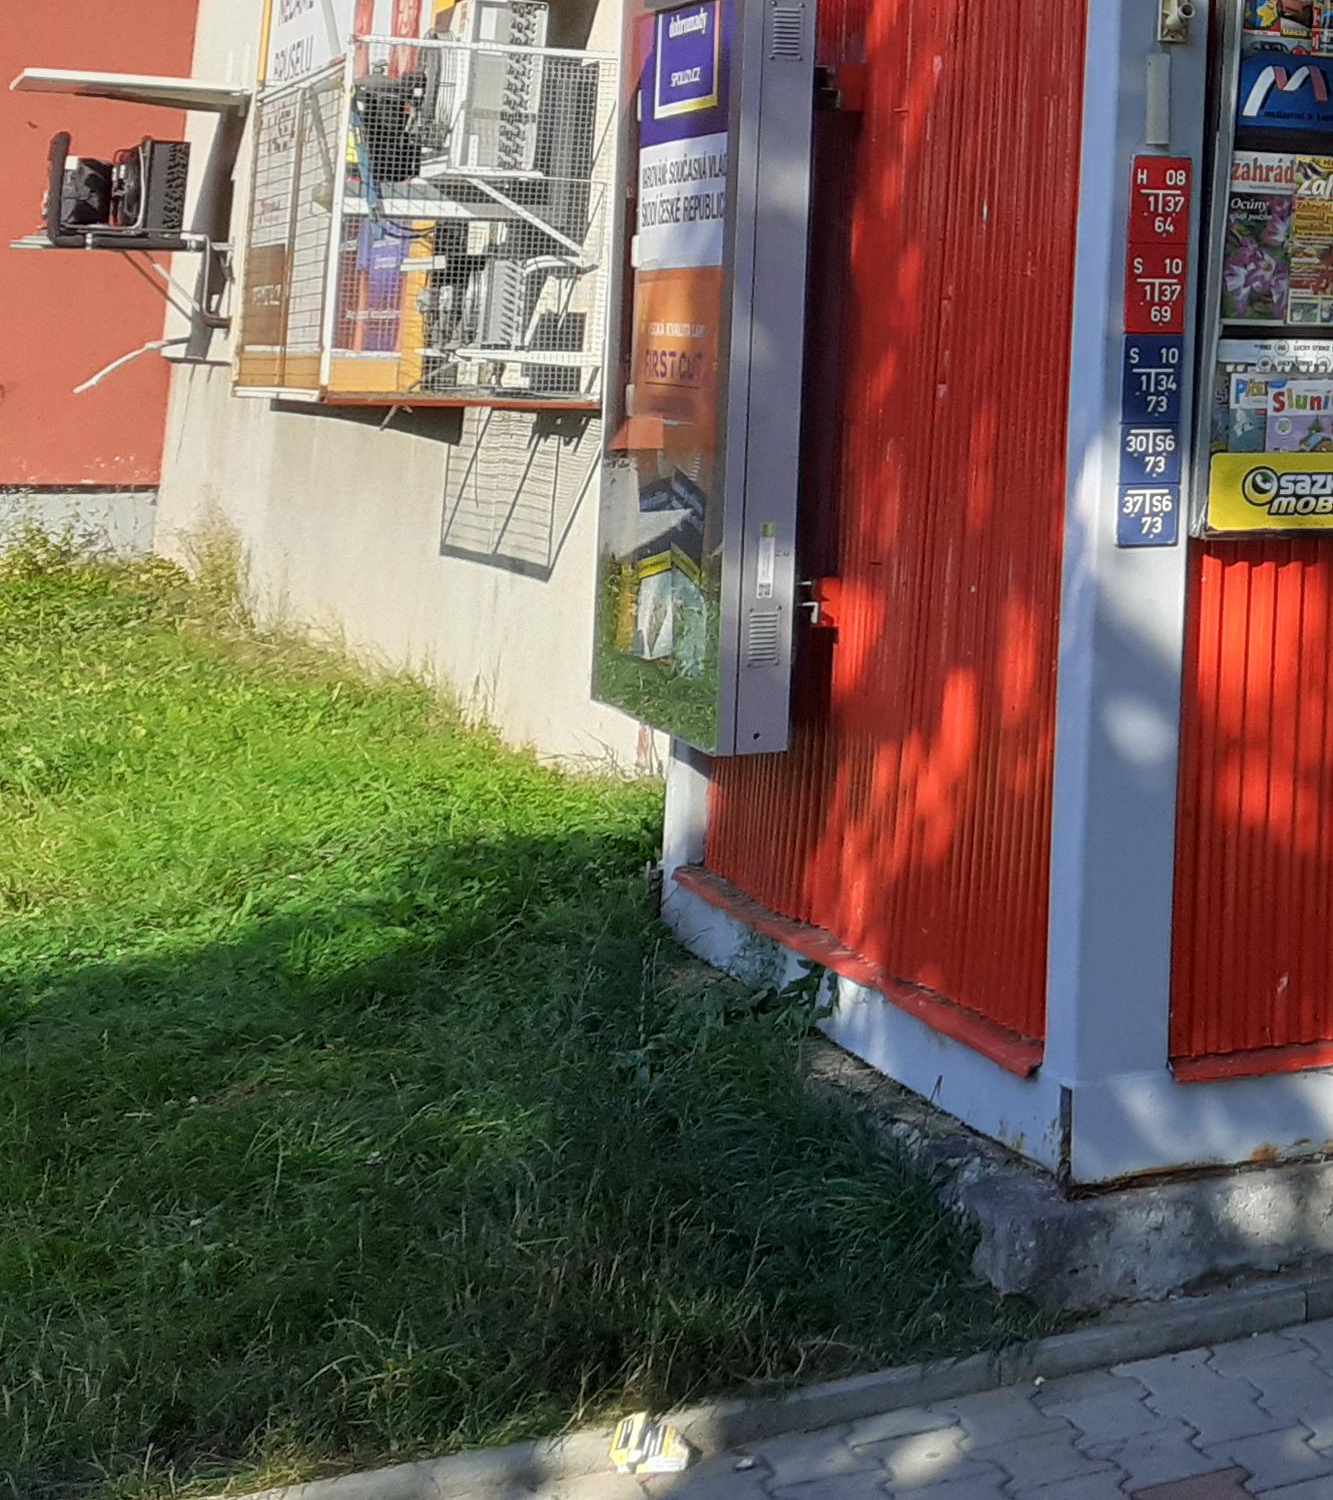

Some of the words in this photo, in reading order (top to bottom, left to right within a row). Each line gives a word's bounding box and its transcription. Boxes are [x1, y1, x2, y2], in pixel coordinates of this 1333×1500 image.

[1137, 168, 1147, 185] H
[1165, 169, 1186, 186] 08
[1165, 196, 1185, 213] 37
[1154, 216, 1174, 233] 64
[1133, 257, 1144, 274] S
[1164, 258, 1183, 274] 10
[1161, 285, 1181, 302] 37
[1150, 306, 1171, 323] 69
[1129, 347, 1140, 364] S
[1160, 348, 1179, 364] 10
[1157, 375, 1177, 391] 34
[1146, 396, 1168, 413] 73
[1126, 435, 1147, 452] 30
[1144, 457, 1166, 474] 73
[1122, 496, 1144, 514] 37
[1141, 517, 1163, 534] 73
